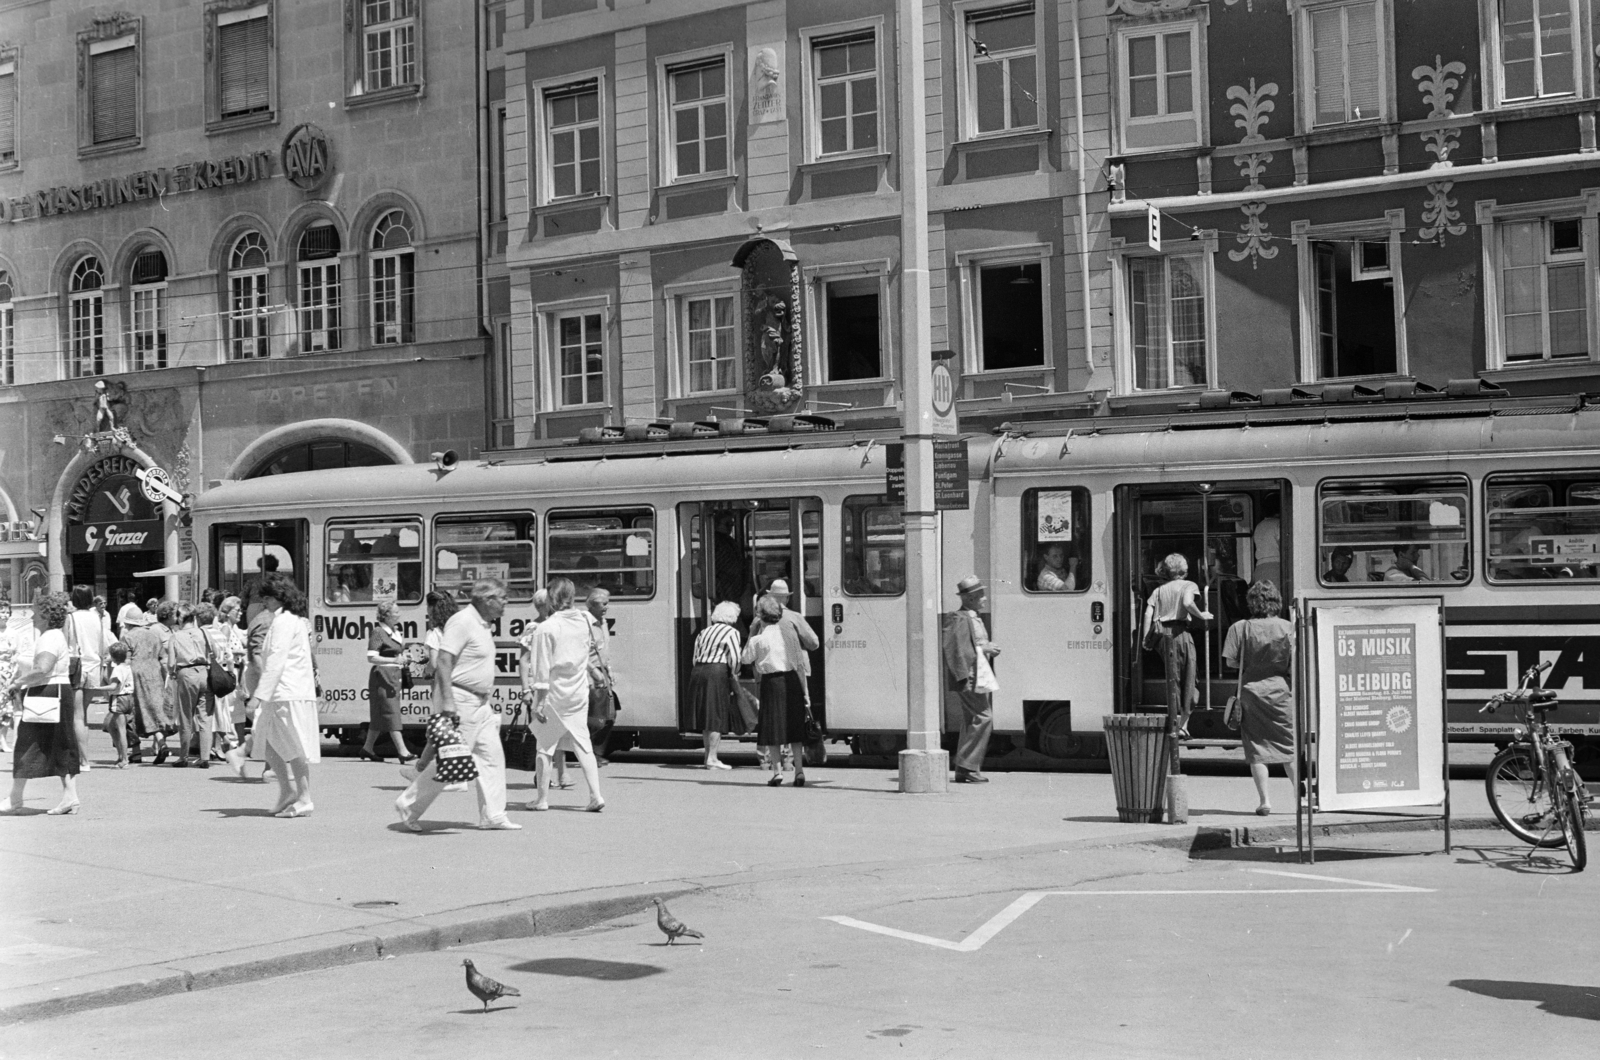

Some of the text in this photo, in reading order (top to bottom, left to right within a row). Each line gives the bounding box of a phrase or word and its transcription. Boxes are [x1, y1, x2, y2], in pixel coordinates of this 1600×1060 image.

[287, 136, 327, 180] AVA
[35, 167, 167, 218] MASCHINEN
[193, 149, 273, 190] KREDIT
[1151, 213, 1158, 243] E
[105, 524, 149, 546] Grazer
[1537, 543, 1548, 560] 5
[1067, 640, 1103, 650] EINSTIEG
[1338, 635, 1411, 657] Ö3 MUSIK
[1339, 672, 1412, 692] BLEIBURG
[325, 689, 356, 701] 8053
